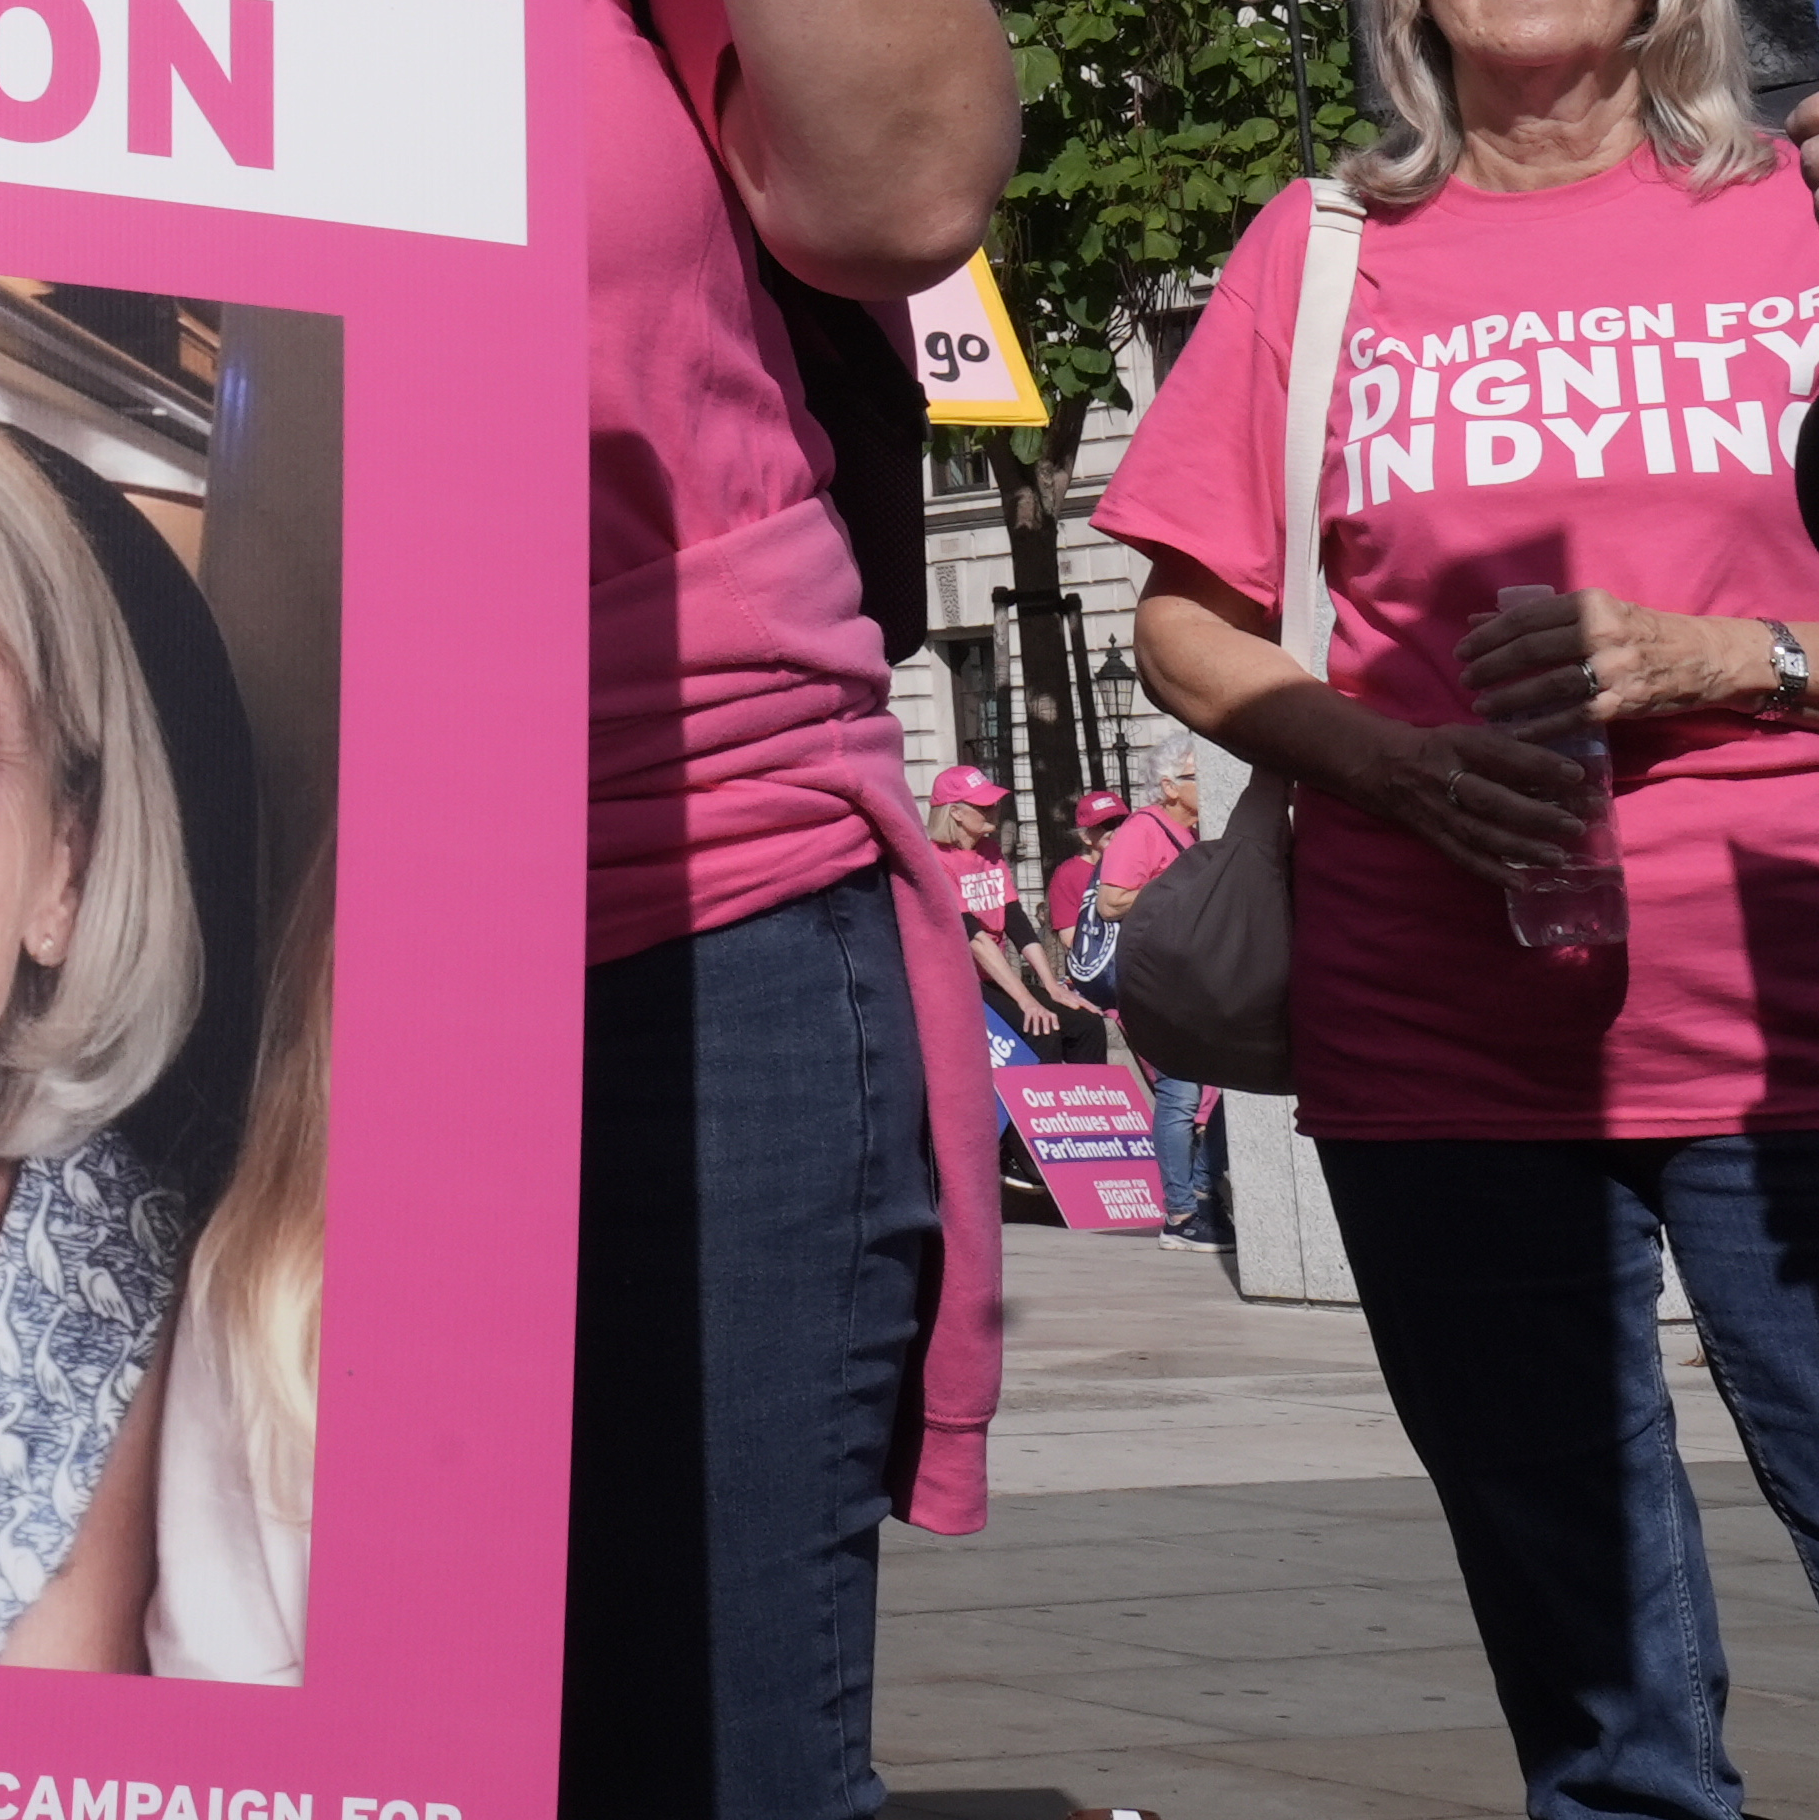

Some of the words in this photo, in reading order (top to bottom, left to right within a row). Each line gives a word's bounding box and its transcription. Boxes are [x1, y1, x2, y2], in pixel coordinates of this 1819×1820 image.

[1350, 303, 1676, 369] CAMPAIGN
[924, 331, 990, 383] go
[1346, 323, 1819, 444] DIGNITY
[1343, 423, 1435, 516] IN
[1022, 1087, 1056, 1108] Our
[1059, 1085, 1132, 1109] suffering
[1030, 1111, 1111, 1134] continues
[1111, 1111, 1150, 1131] until
[1034, 1137, 1127, 1160] Parliament
[1097, 1188, 1152, 1205] DIGNITY
